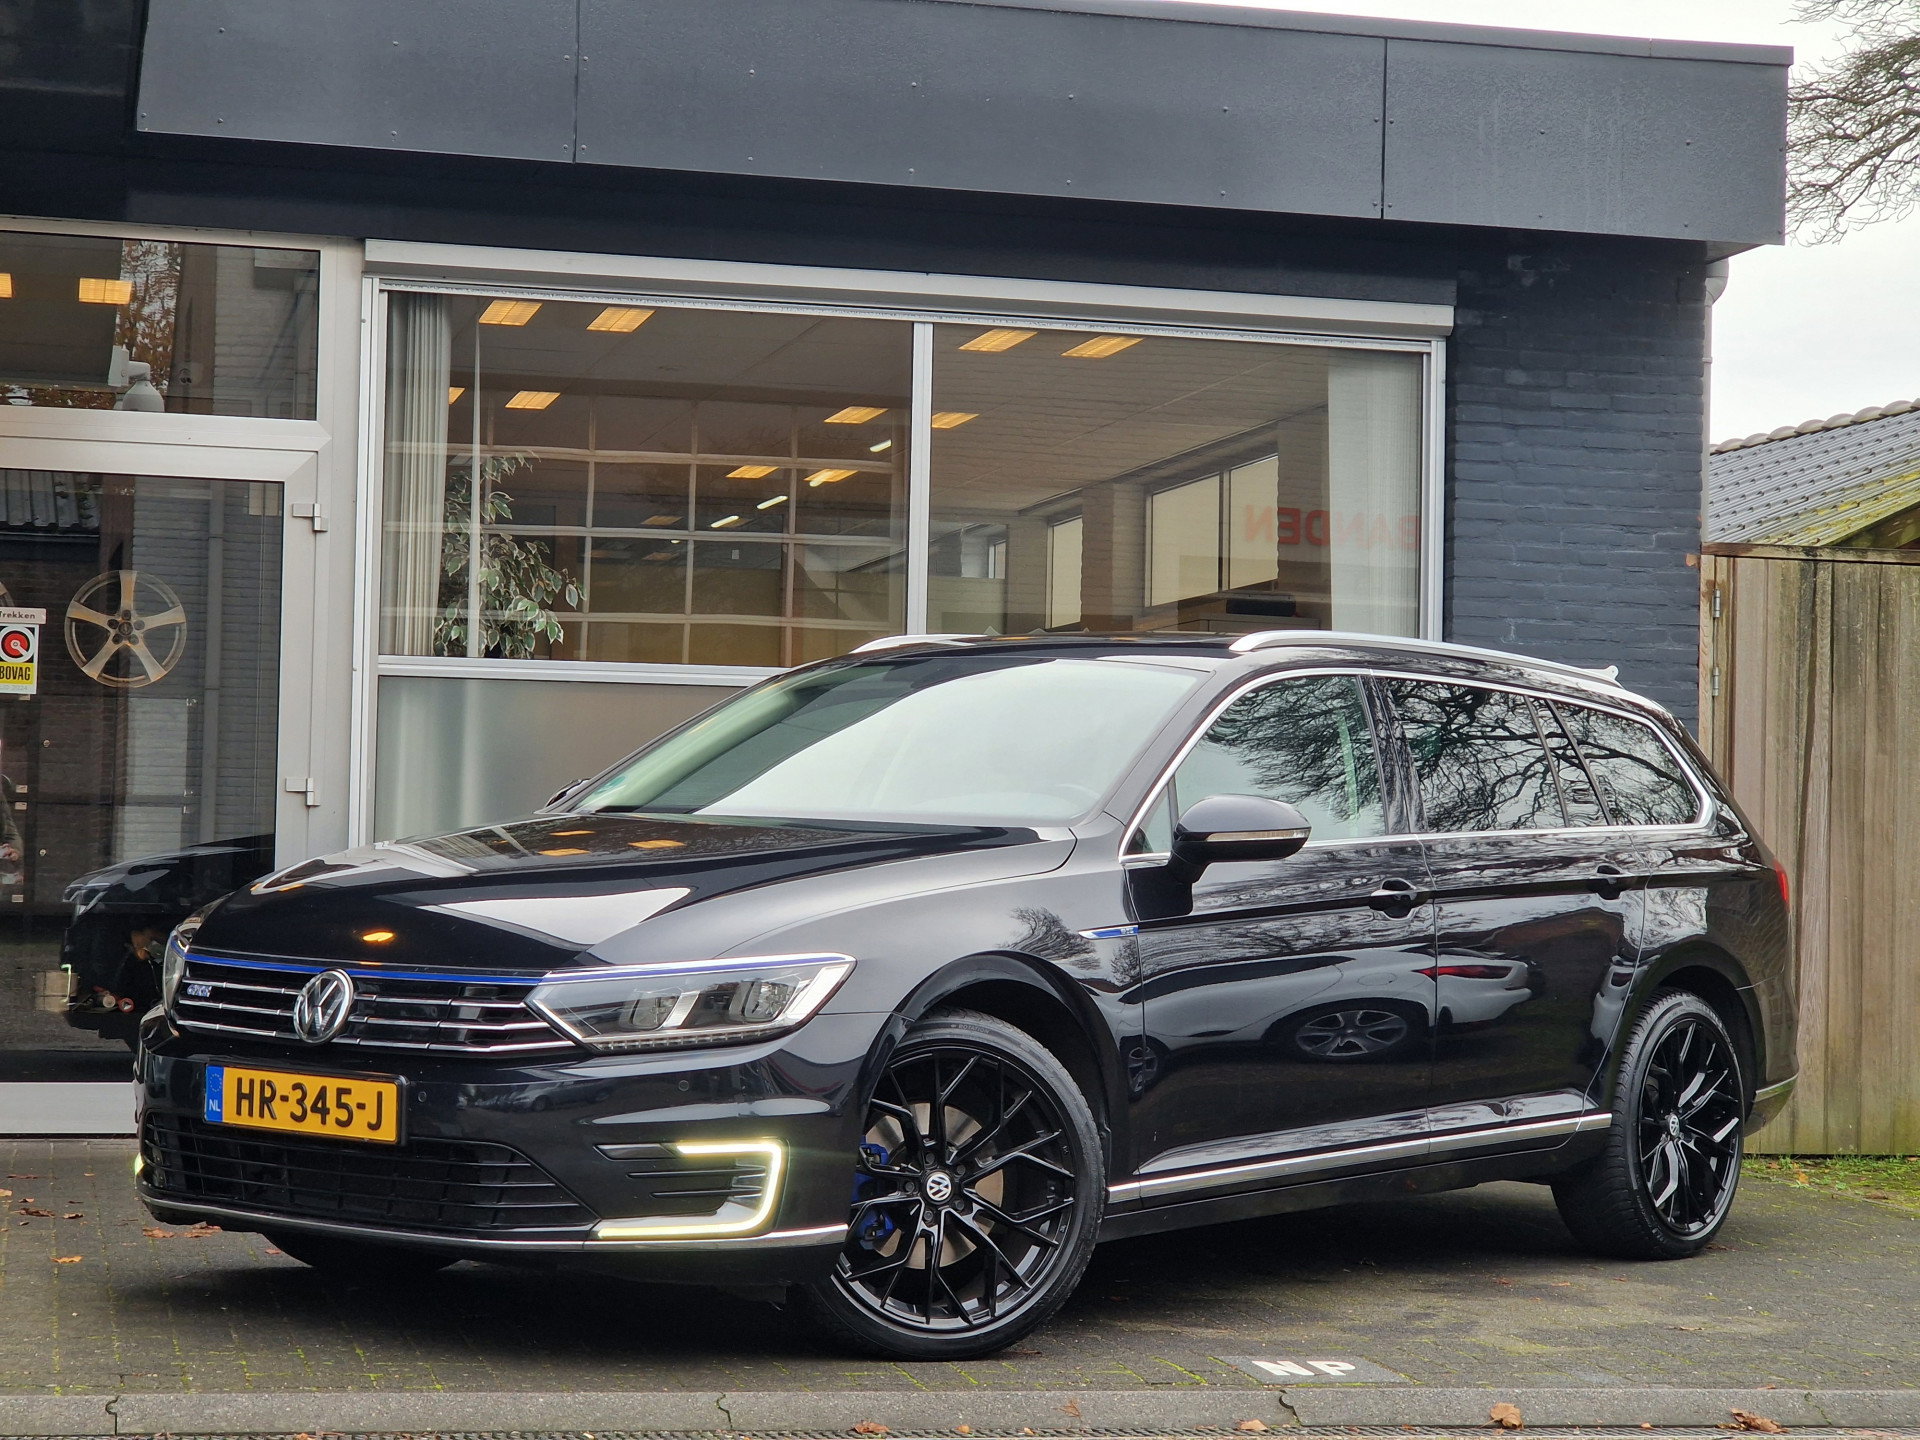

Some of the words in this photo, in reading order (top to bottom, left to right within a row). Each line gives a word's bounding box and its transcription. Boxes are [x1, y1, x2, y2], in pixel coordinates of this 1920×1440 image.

[0, 665, 31, 681] BOVAG
[208, 1098, 221, 1113] NL
[235, 1077, 384, 1131] HR-345-J
[1251, 1360, 1357, 1376] NP
